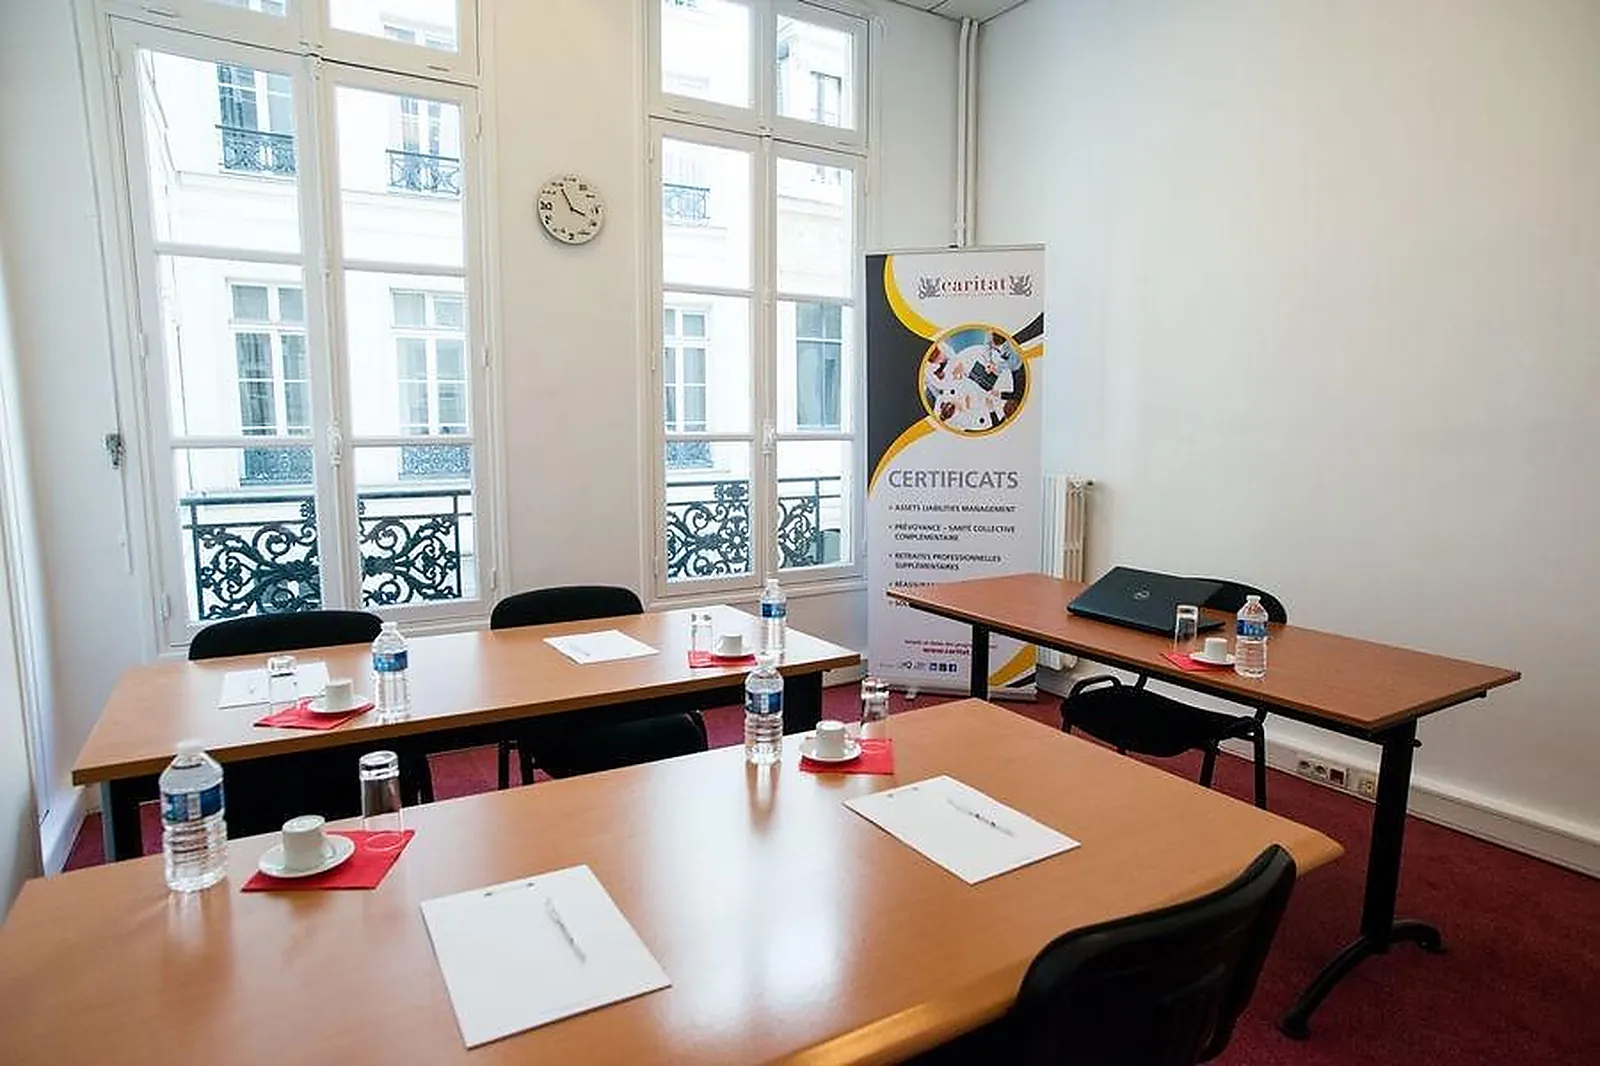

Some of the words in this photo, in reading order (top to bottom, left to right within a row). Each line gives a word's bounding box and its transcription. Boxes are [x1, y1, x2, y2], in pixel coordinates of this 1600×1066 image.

[941, 275, 1006, 292] caritat
[888, 470, 1018, 488] CERTIFICATS
[895, 504, 920, 512] ASSETS
[922, 504, 960, 512] LIABILITIES
[961, 505, 1016, 513] MANAGEMENT
[973, 524, 1015, 533] COLLECTIVE
[895, 552, 931, 560] RETRAITES
[932, 553, 1001, 562] PROFESSIONNELLES
